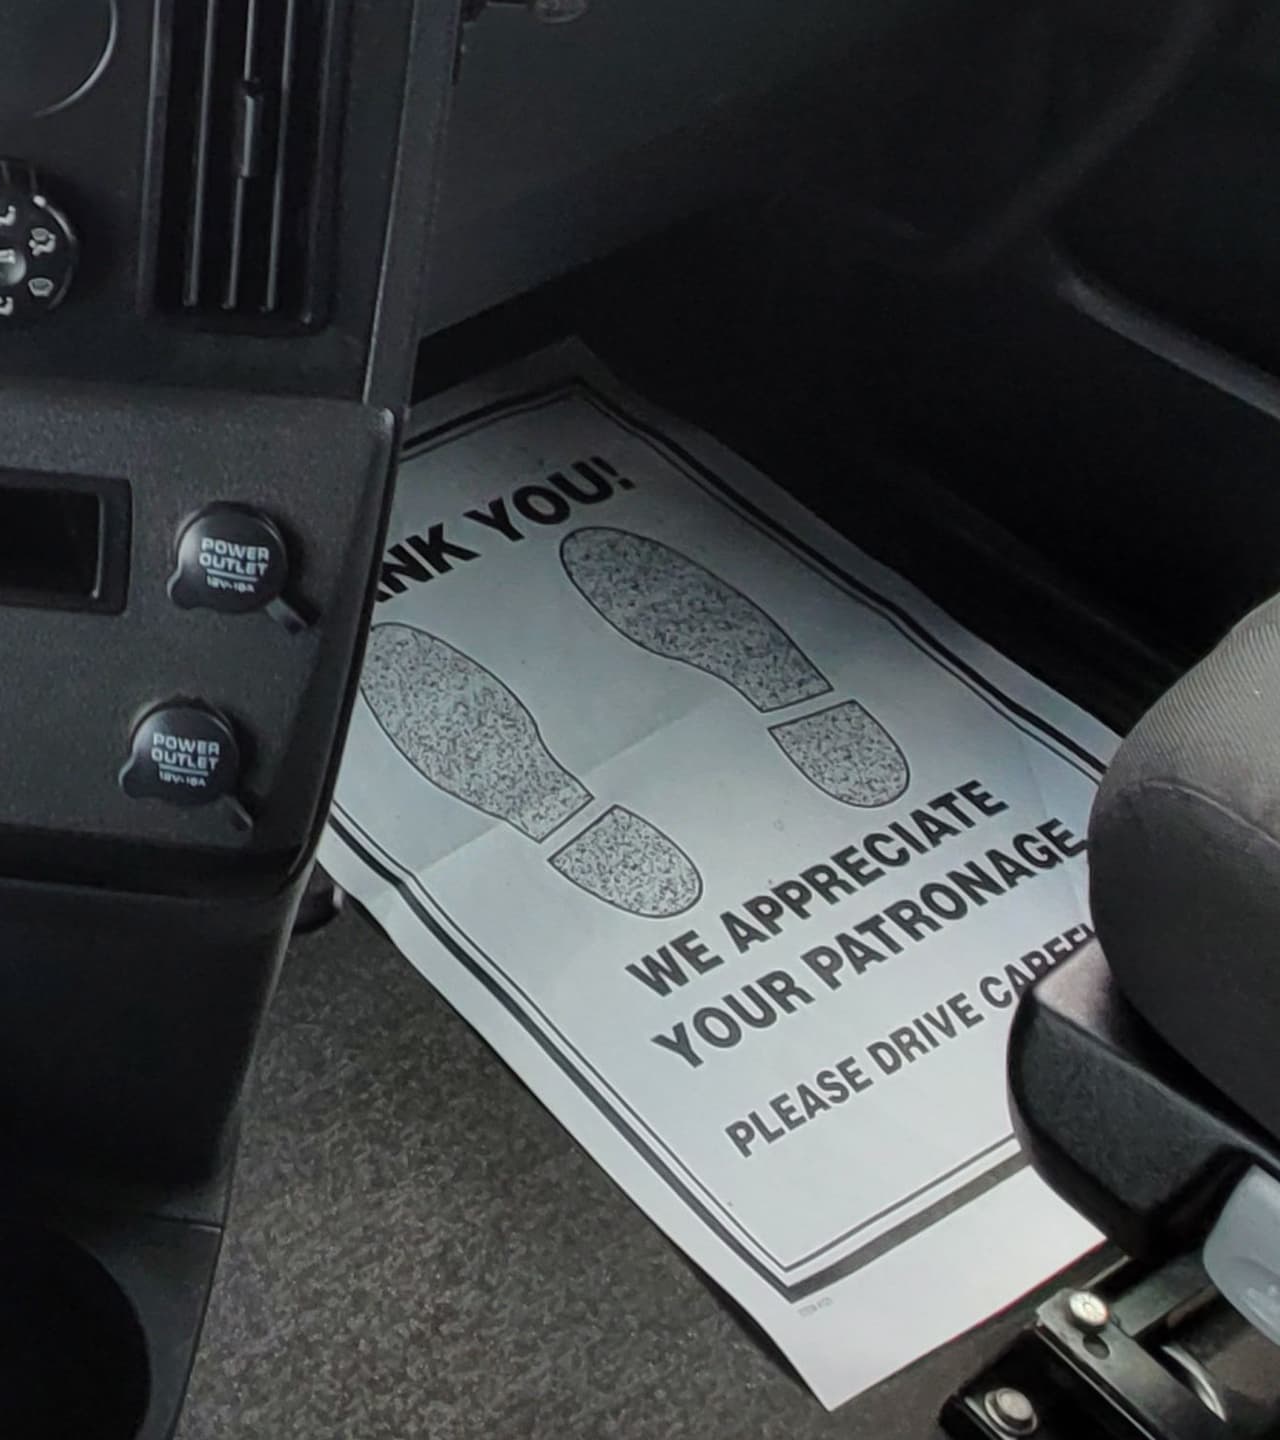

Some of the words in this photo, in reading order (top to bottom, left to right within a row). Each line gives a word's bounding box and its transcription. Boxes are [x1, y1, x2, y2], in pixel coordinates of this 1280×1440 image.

[468, 456, 636, 544] YOU!
[199, 552, 268, 576] OUTLET
[201, 537, 270, 560] POWER
[151, 748, 218, 770] OUTLET
[152, 732, 220, 755] POWER
[625, 929, 725, 999] WE
[719, 779, 1010, 945] APPRECIATE
[650, 969, 815, 1071] YOUR
[724, 1050, 874, 1158] PLEASE
[873, 992, 986, 1076] DRIVE
